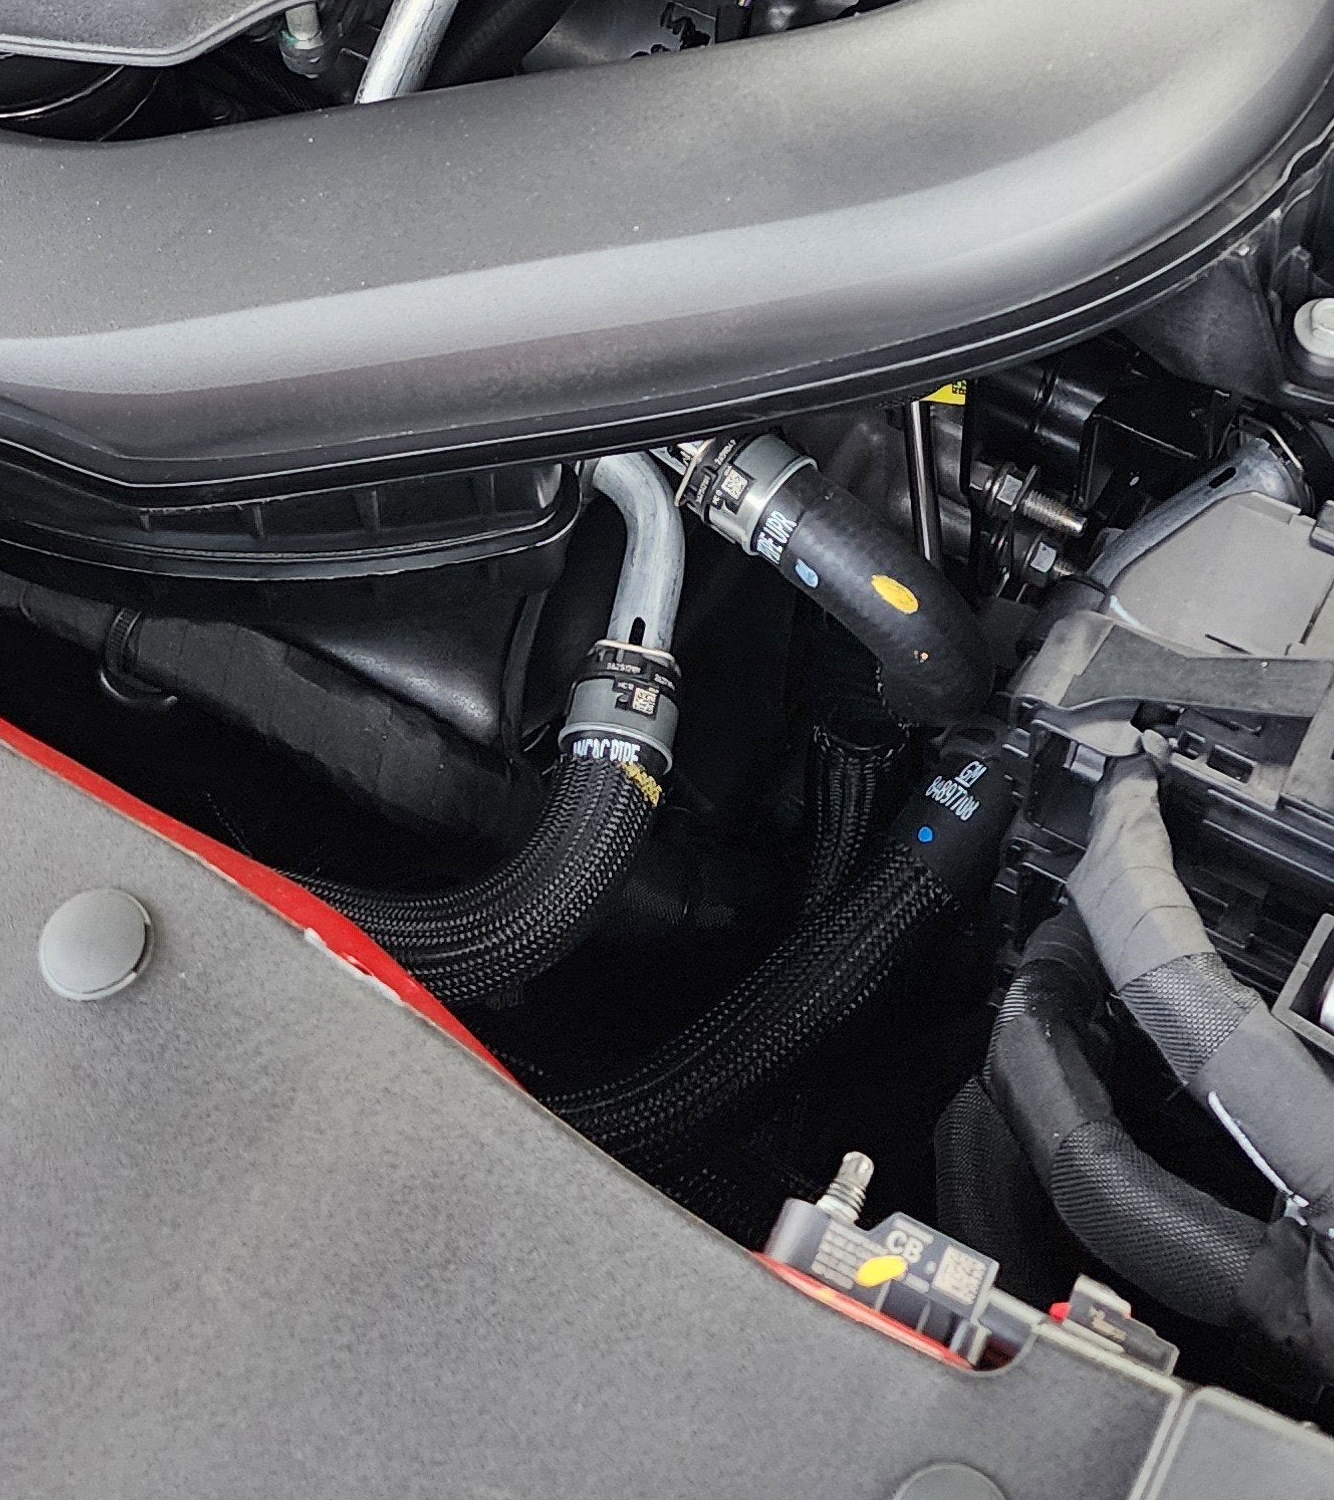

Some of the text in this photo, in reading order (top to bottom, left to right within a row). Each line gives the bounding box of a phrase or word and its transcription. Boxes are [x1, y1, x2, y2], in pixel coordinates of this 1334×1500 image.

[763, 511, 797, 544] UPR
[610, 739, 641, 764] PIPE
[959, 760, 987, 786] GM
[925, 776, 980, 821] 84897708
